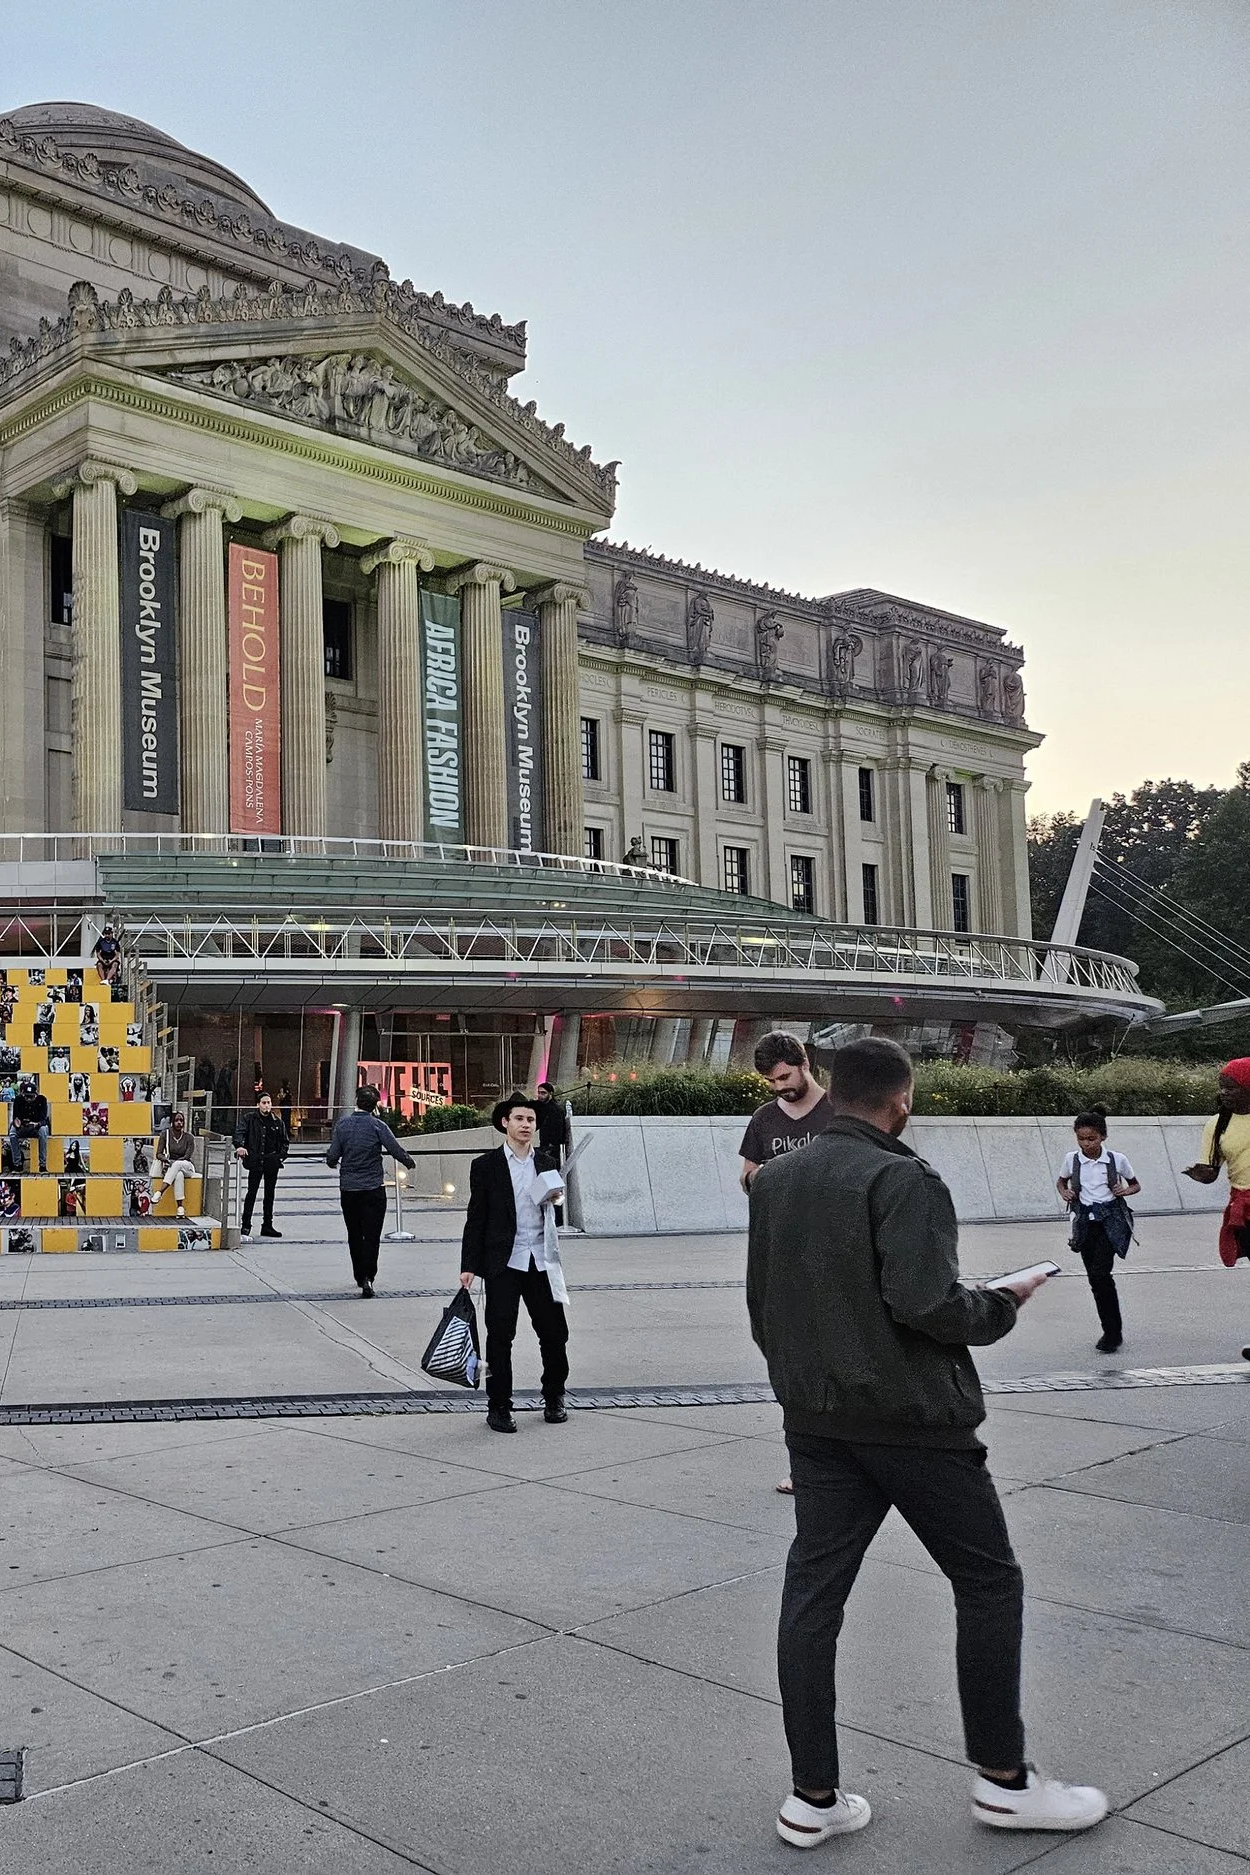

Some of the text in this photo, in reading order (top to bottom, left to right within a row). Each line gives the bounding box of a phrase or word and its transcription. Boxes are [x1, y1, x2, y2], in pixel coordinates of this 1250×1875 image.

[135, 526, 163, 799] Brooklyn Museum
[242, 558, 267, 712] BEHOLD
[425, 618, 460, 829] AFRICA FASHION
[513, 624, 534, 854] Brooklyn Museum
[411, 1090, 444, 1106] SOURCES
